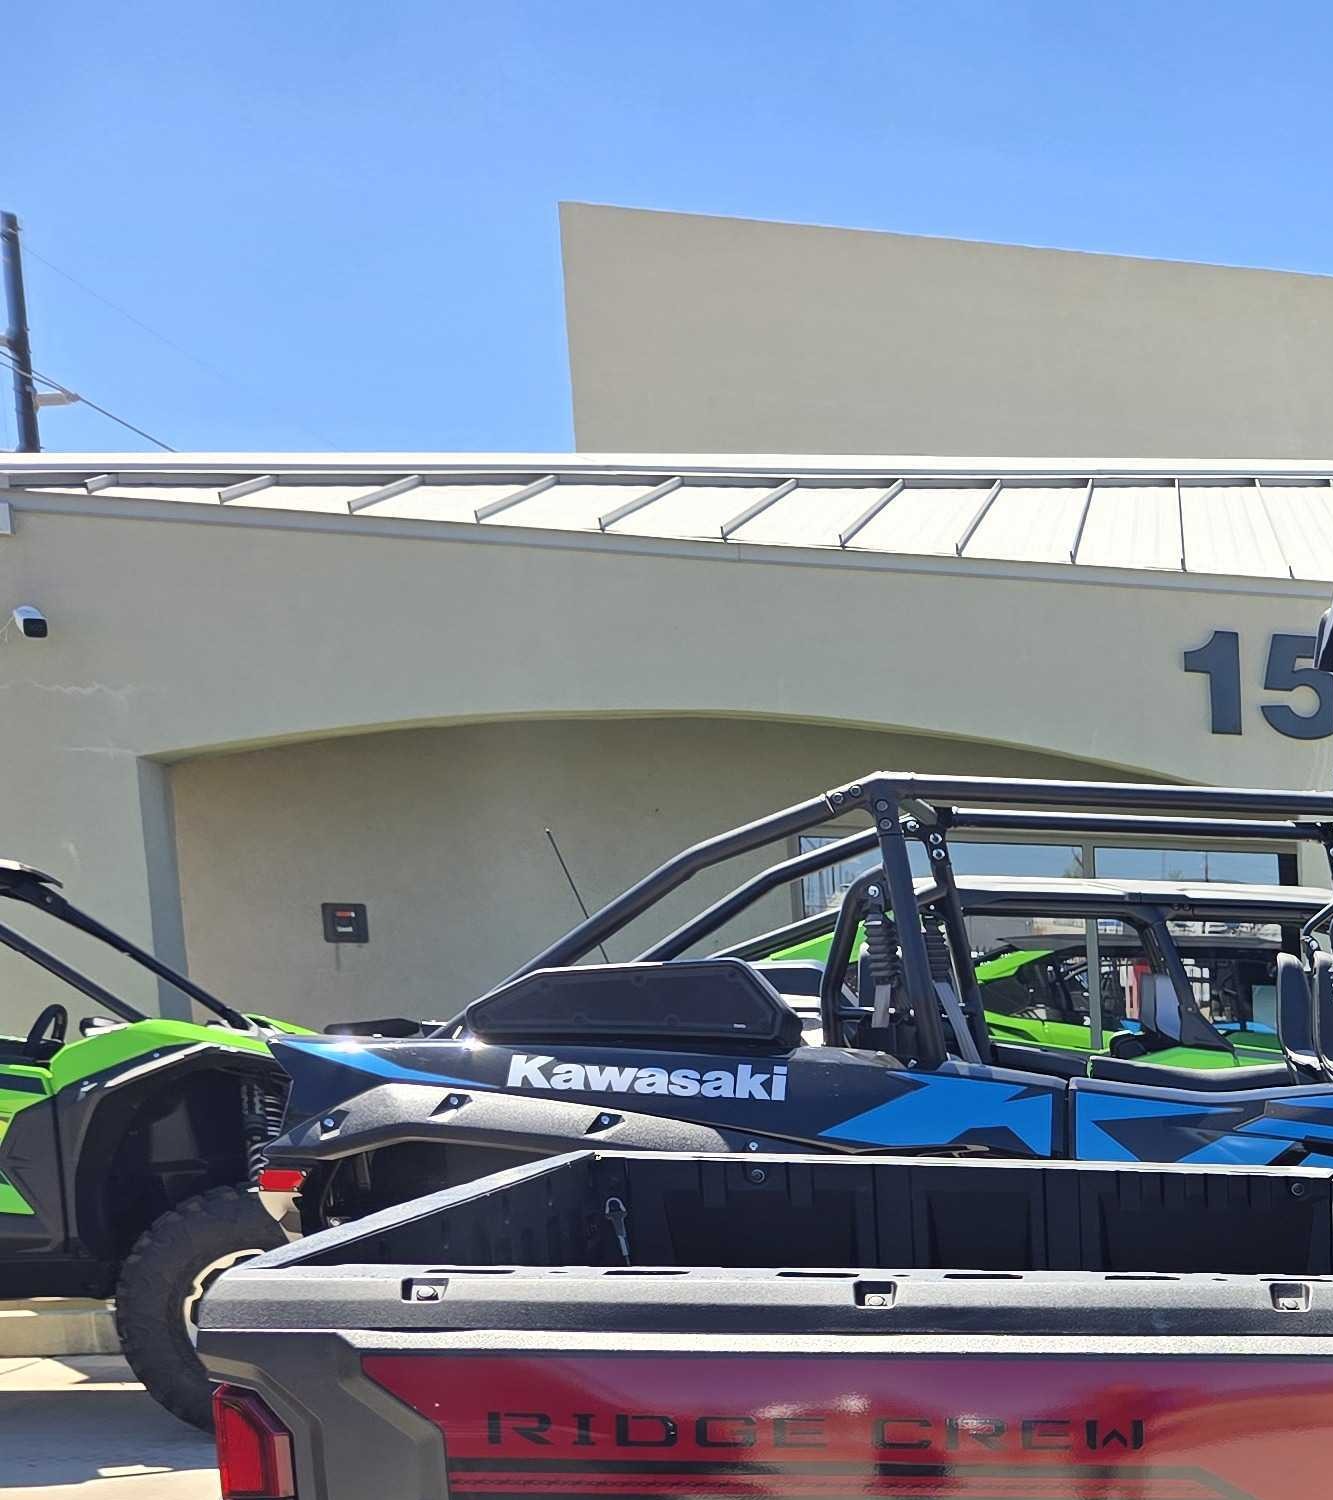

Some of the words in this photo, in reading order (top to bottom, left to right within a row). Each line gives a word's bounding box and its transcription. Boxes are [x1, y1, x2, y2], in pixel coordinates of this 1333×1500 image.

[507, 1054, 788, 1101] Kawasaki
[487, 1411, 828, 1449] RIDGE
[874, 1417, 1143, 1450] CREW
